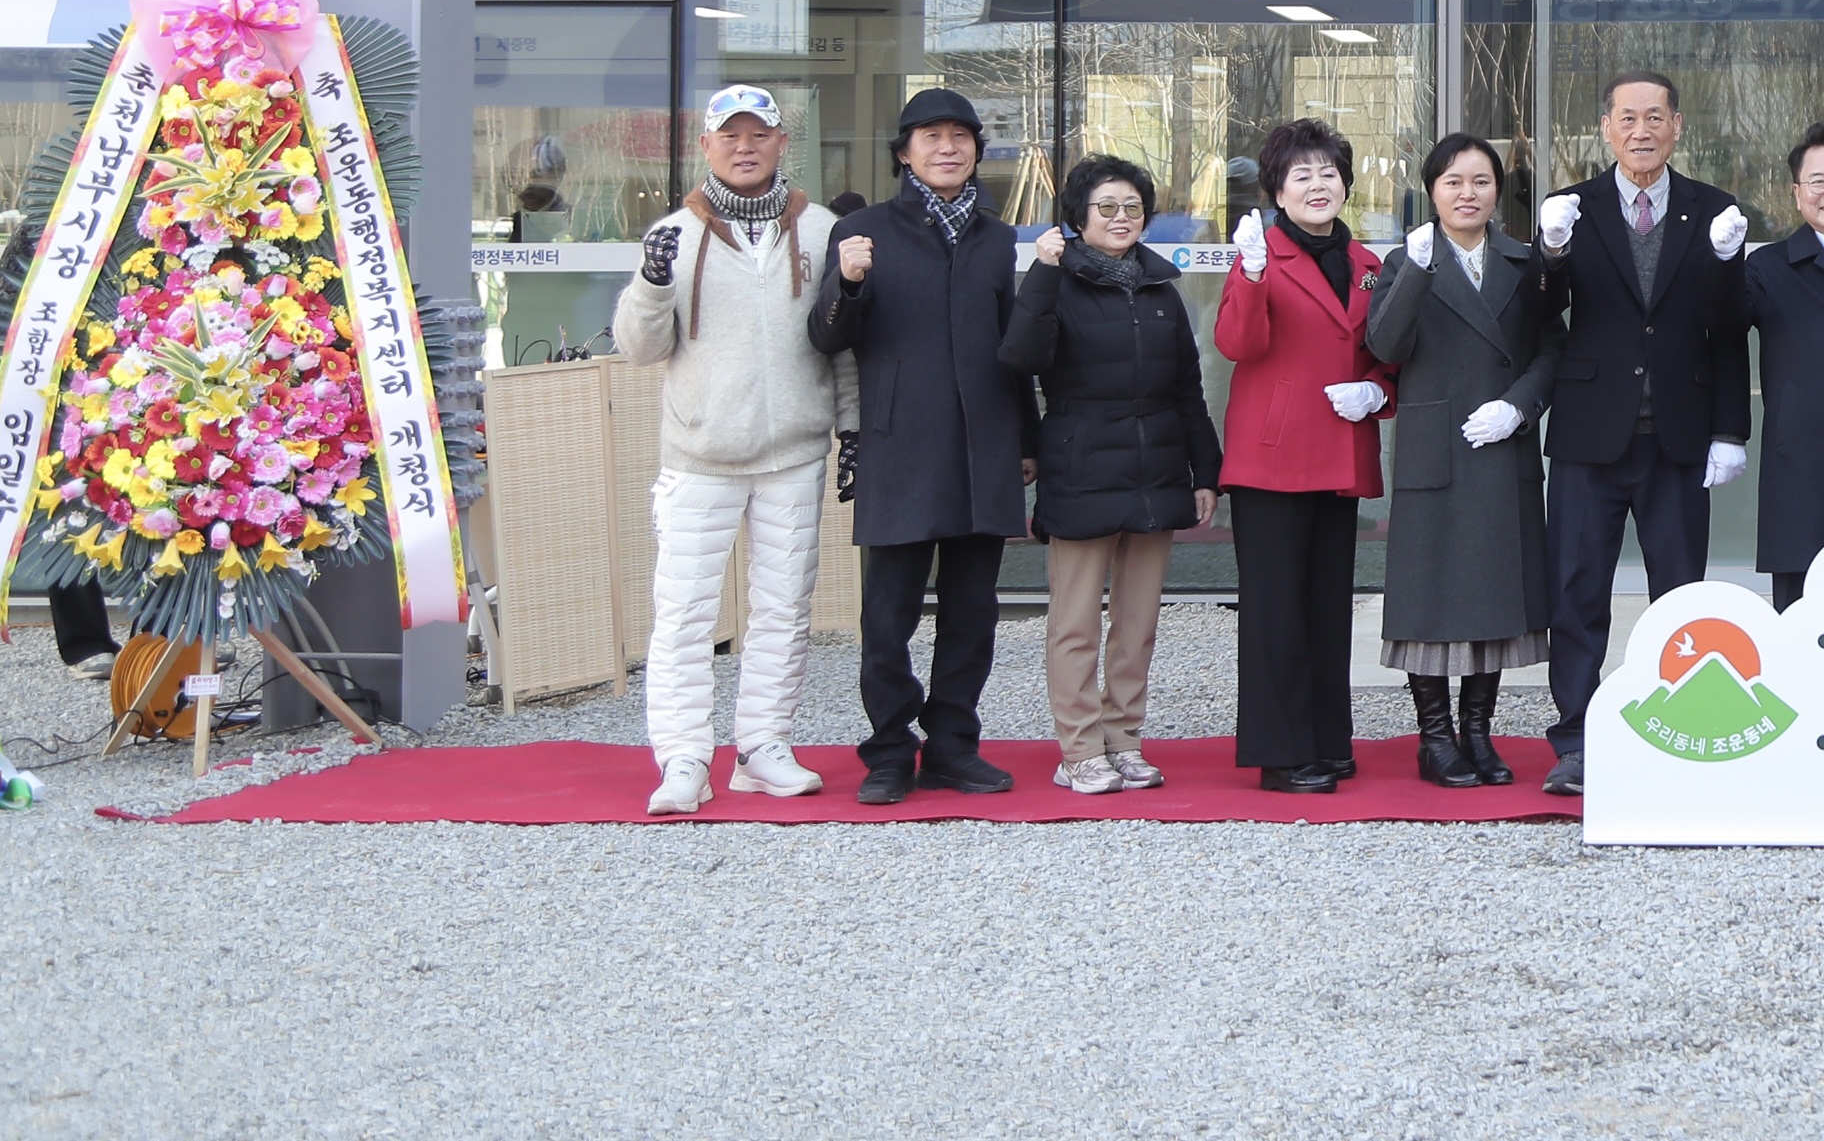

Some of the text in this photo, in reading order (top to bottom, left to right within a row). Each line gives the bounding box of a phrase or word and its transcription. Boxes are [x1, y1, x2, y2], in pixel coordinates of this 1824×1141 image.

[50, 62, 157, 280] 춘천남부시장
[15, 300, 58, 385] 조합장
[311, 73, 437, 519] 축 조운동행정복지센터 개청식
[1644, 715, 1776, 756] 우리동네 조운동네
